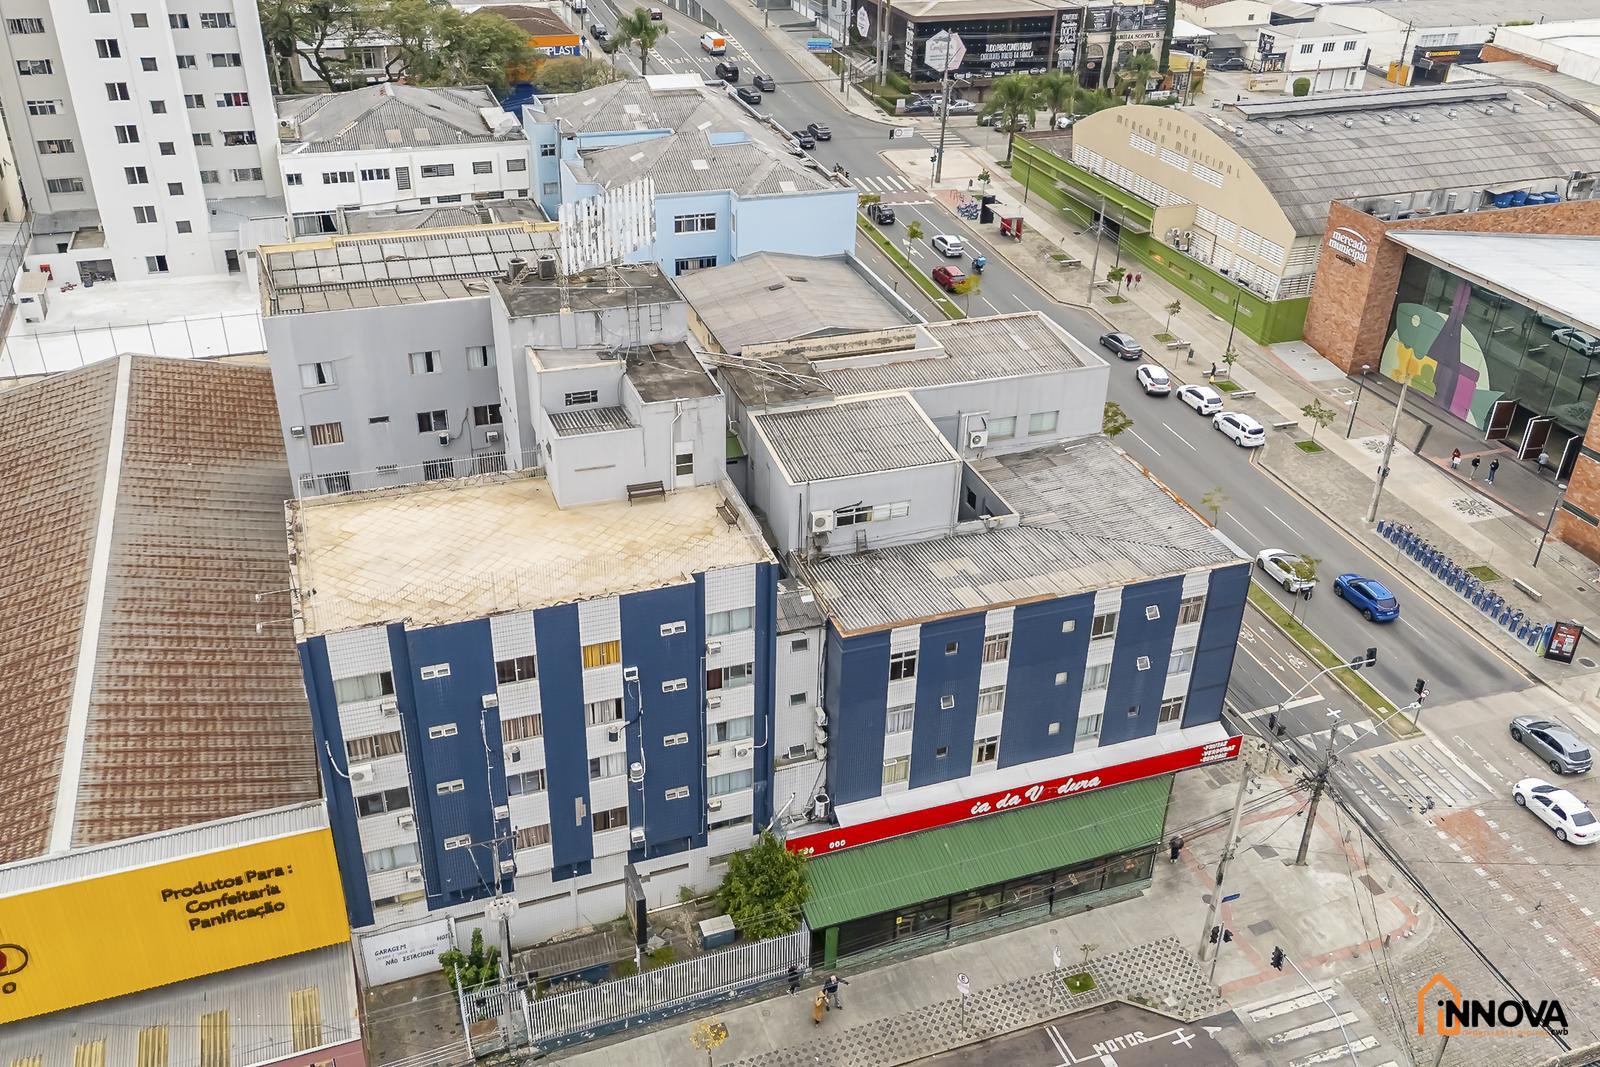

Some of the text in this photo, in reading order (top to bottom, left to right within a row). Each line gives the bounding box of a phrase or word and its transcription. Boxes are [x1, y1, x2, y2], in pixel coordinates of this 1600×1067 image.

[1174, 141, 1241, 179] MUNICIPAL
[1328, 239, 1368, 264] municipal
[1332, 231, 1367, 253] mercado
[996, 793, 1021, 809] da
[161, 875, 244, 902] Produtos
[185, 884, 281, 913] Confeitaria
[188, 901, 286, 931] Panificação
[374, 943, 407, 957] GARAGEM
[402, 948, 436, 962] ESTACIONE
[1092, 1031, 1149, 1056] MOTOS
